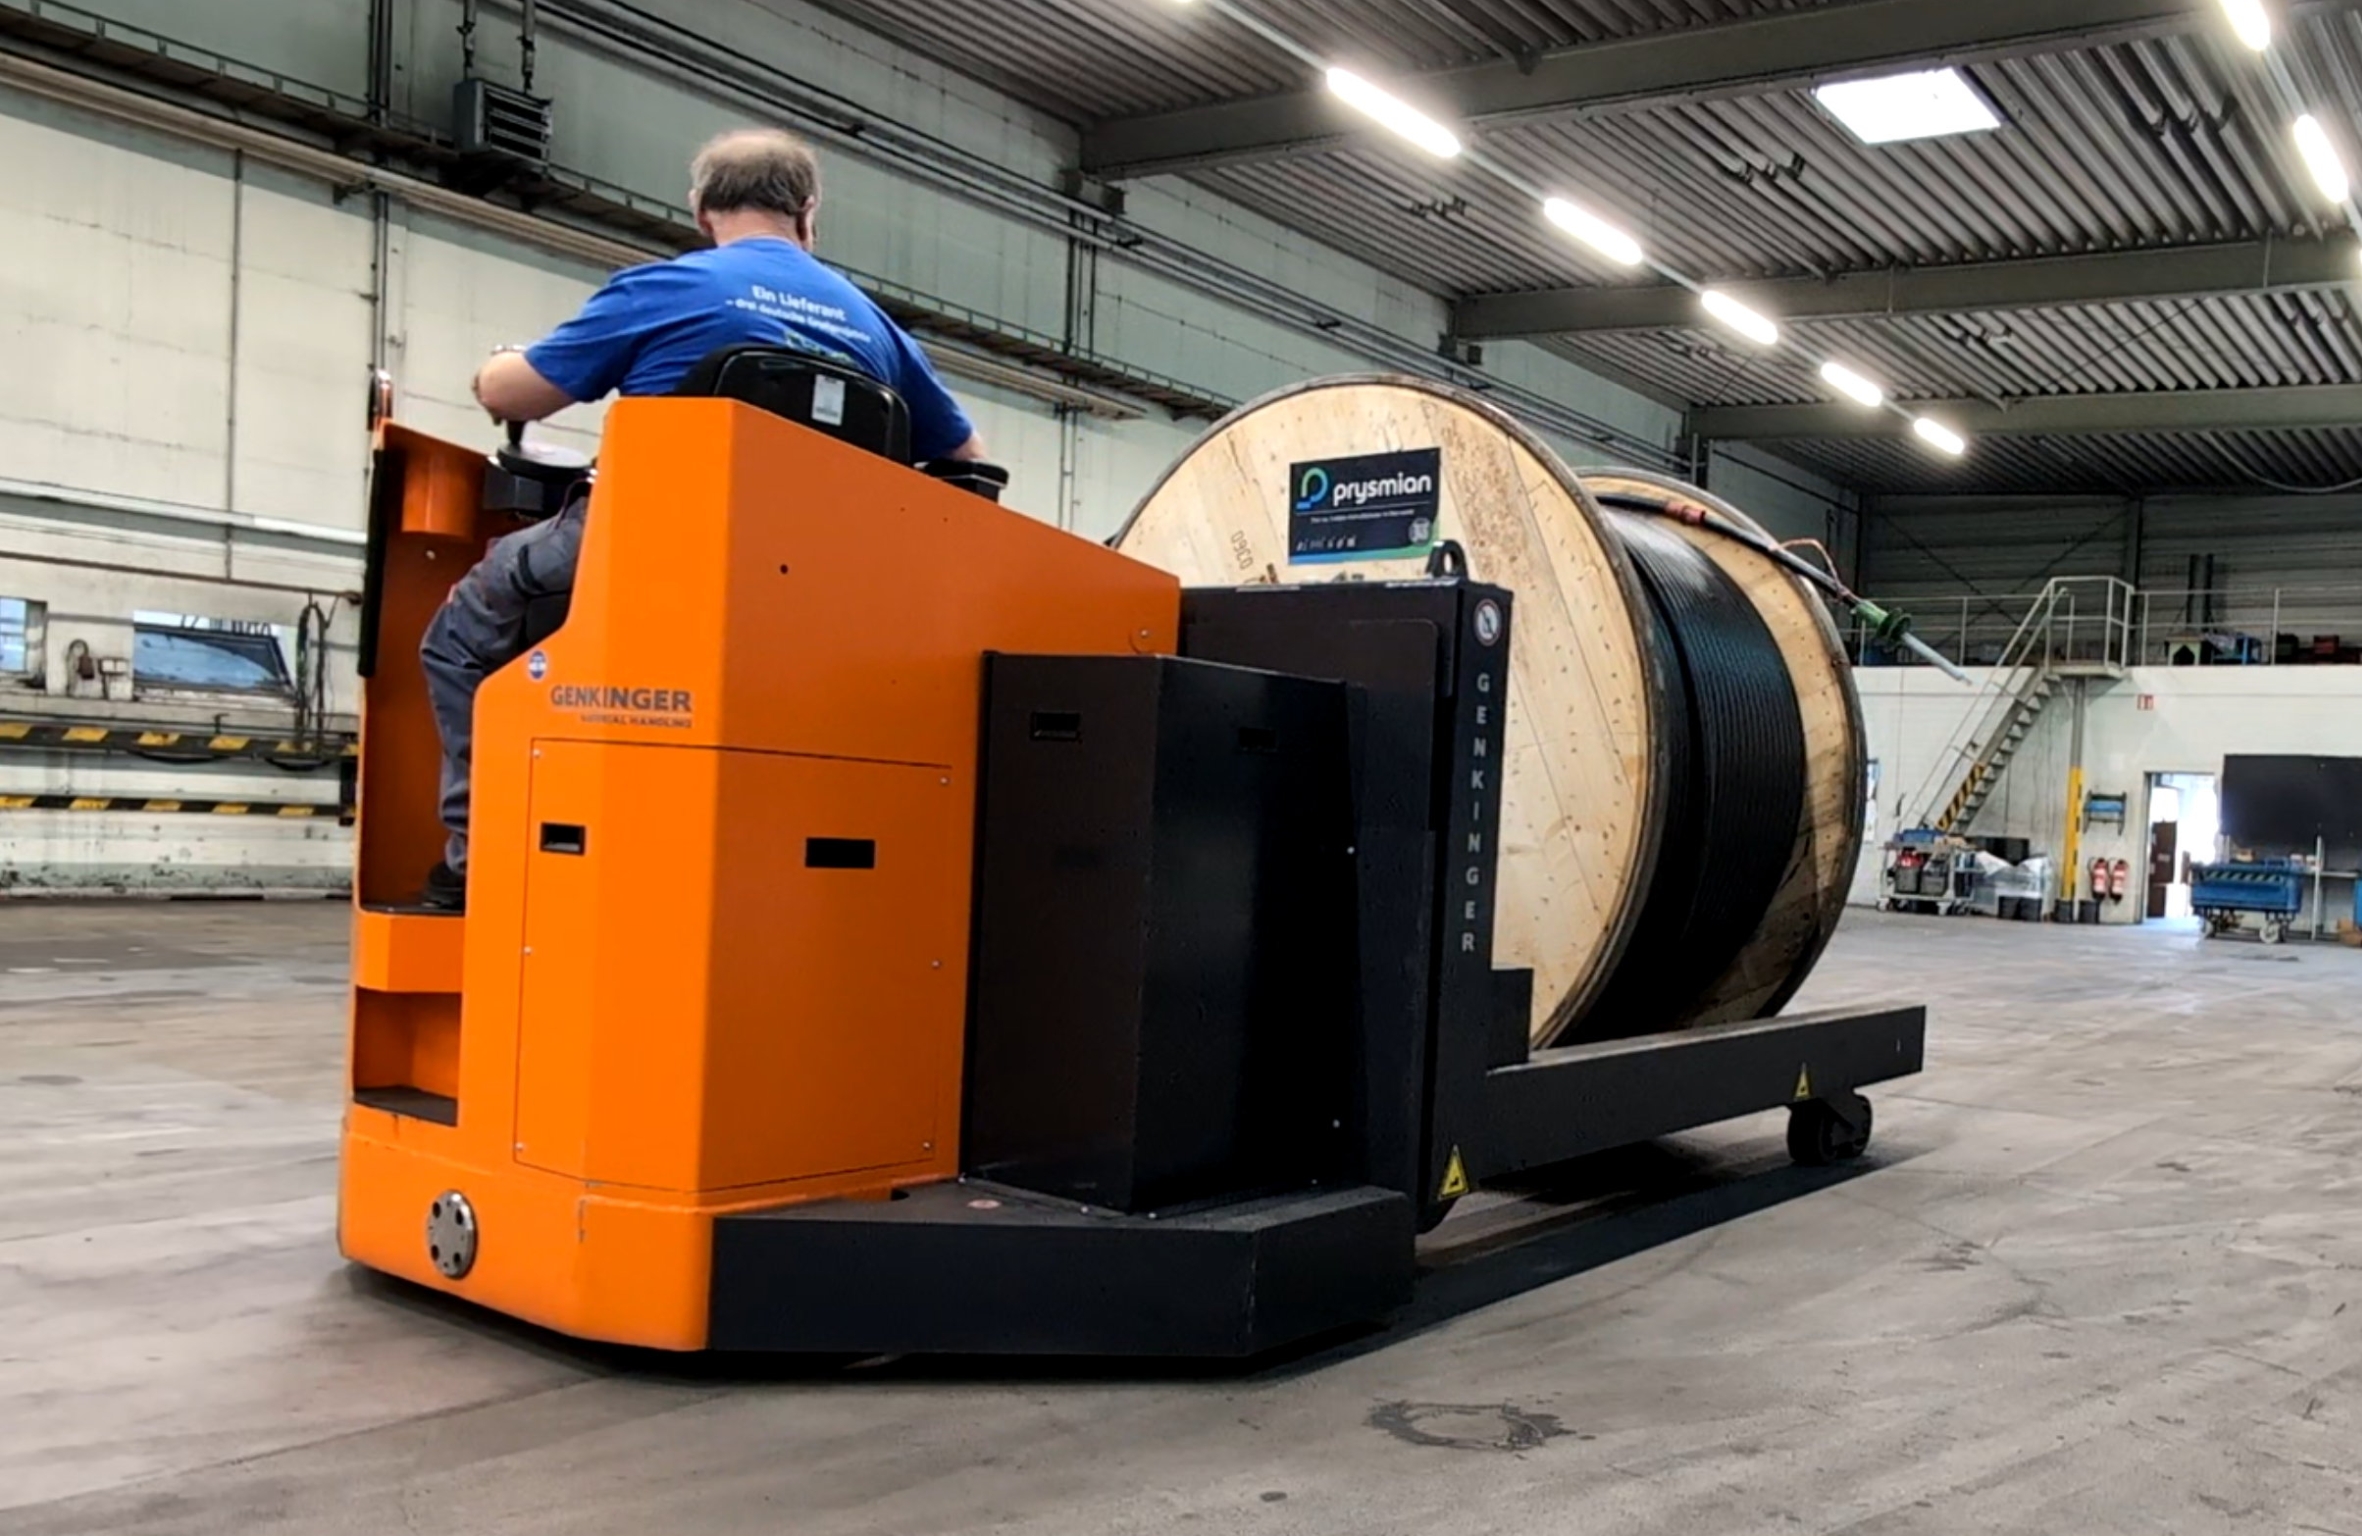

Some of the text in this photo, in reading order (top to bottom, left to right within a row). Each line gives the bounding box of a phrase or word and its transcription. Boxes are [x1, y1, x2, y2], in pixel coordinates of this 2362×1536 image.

[751, 285, 846, 321] Ein Lieferant
[1332, 472, 1432, 507] prysmian
[551, 685, 692, 712] GENKINGER
[1461, 672, 1490, 952] GENKINGER
